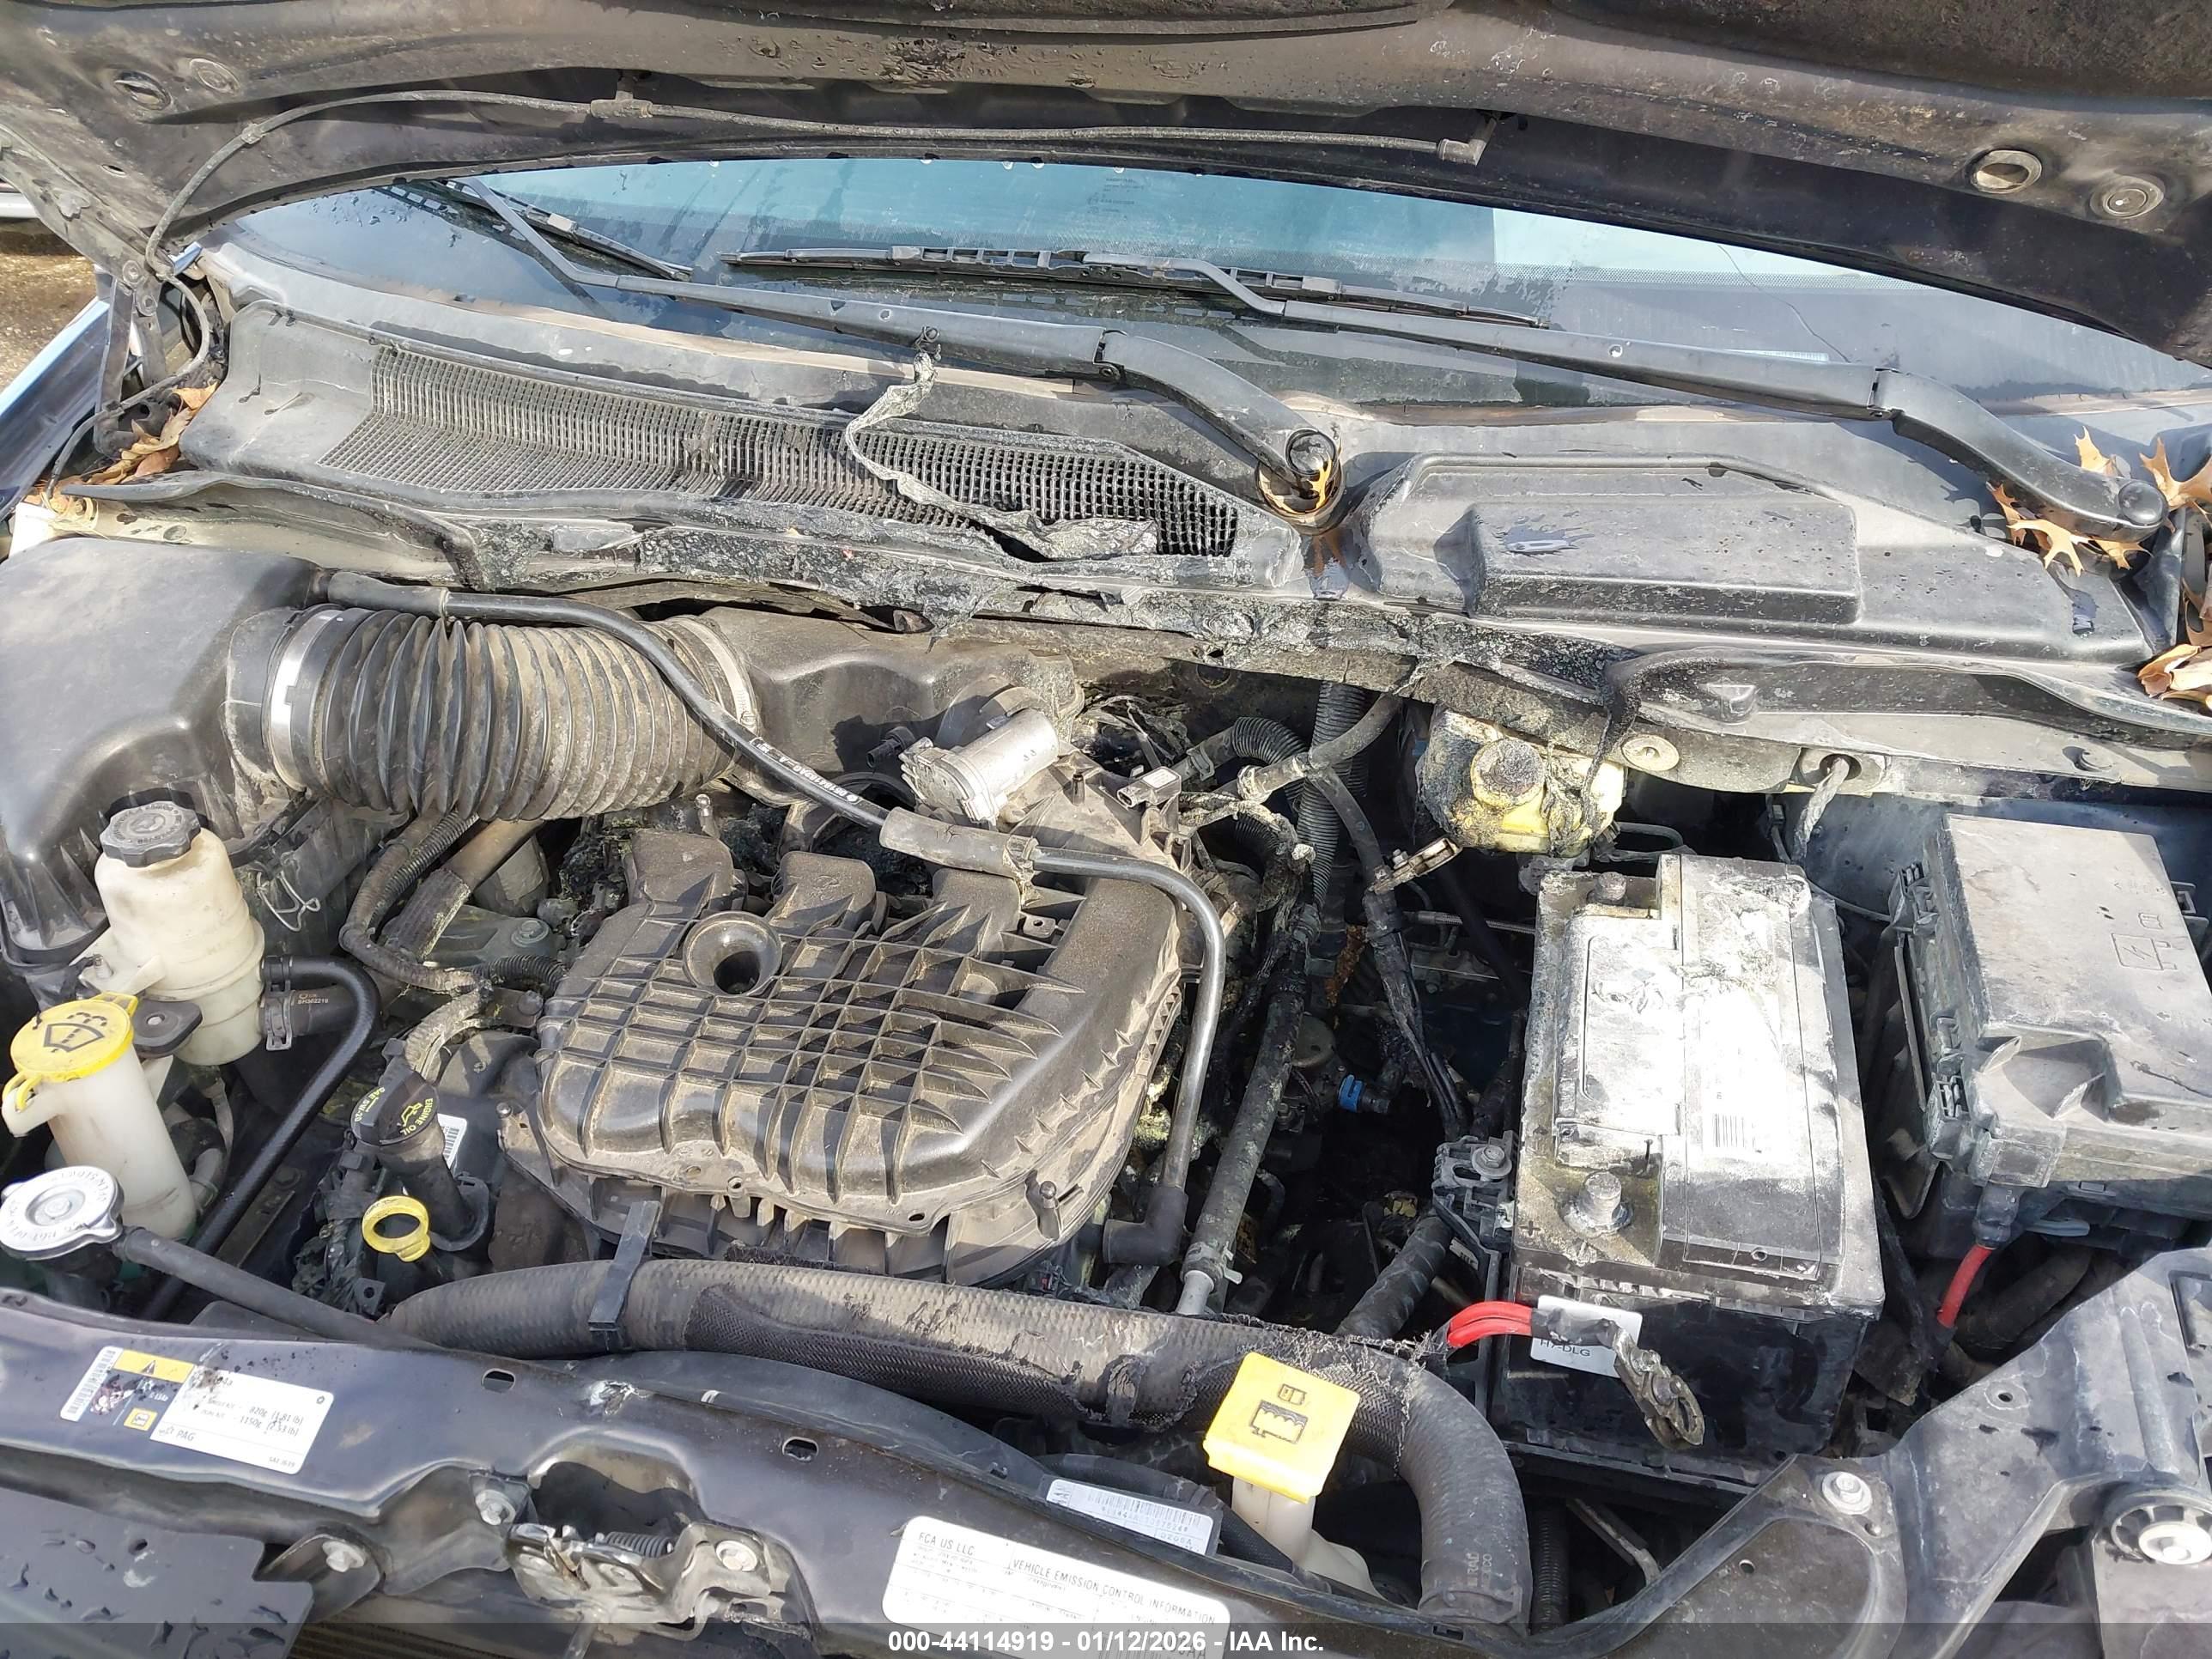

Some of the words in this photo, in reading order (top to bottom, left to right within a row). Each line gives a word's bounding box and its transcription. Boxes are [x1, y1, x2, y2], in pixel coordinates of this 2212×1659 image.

[368, 1086, 386, 1101] SAE
[416, 1098, 434, 1126] ENGINE
[399, 1124, 417, 1136] OIL
[176, 1429, 195, 1442] PAG
[918, 1532, 937, 1547] FCA
[940, 1538, 953, 1550] US
[957, 1542, 975, 1556] LLC
[1013, 1559, 1052, 1578] VEHICLE
[1054, 1570, 1099, 1593] EMISSION
[1102, 1583, 1145, 1606] CONTROL
[1148, 1598, 1216, 1626] INFORMATION
